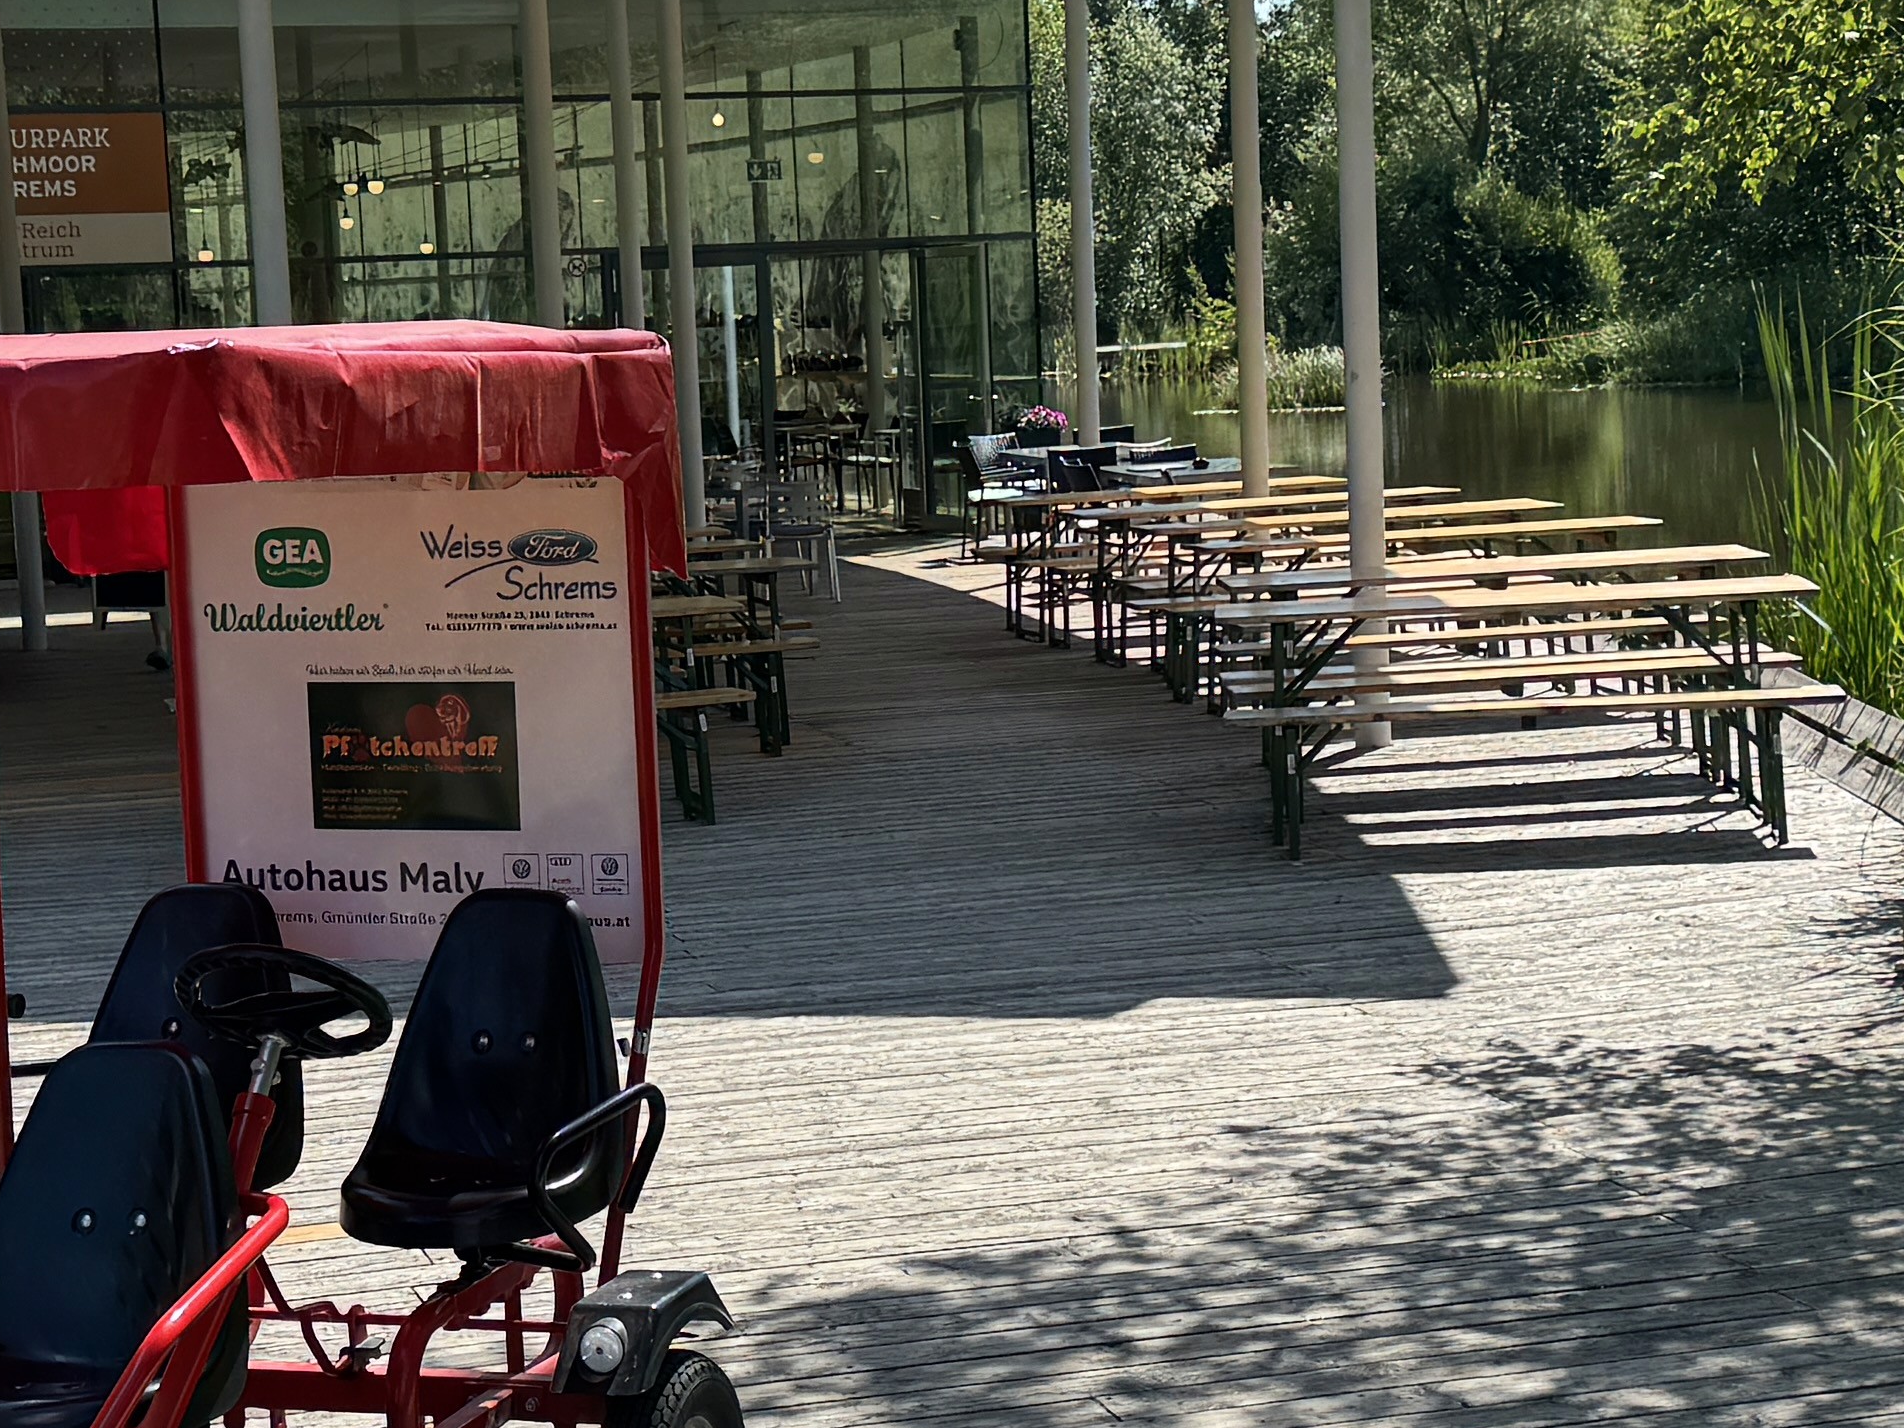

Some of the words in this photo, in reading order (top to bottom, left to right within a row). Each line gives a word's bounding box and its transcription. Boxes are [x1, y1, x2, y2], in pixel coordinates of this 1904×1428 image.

[262, 538, 324, 565] GEA
[420, 524, 503, 560] Weiss
[523, 533, 581, 561] Ford
[496, 566, 618, 602] Schrems
[203, 602, 386, 633] Waldviertler
[223, 859, 388, 892] Autohaus
